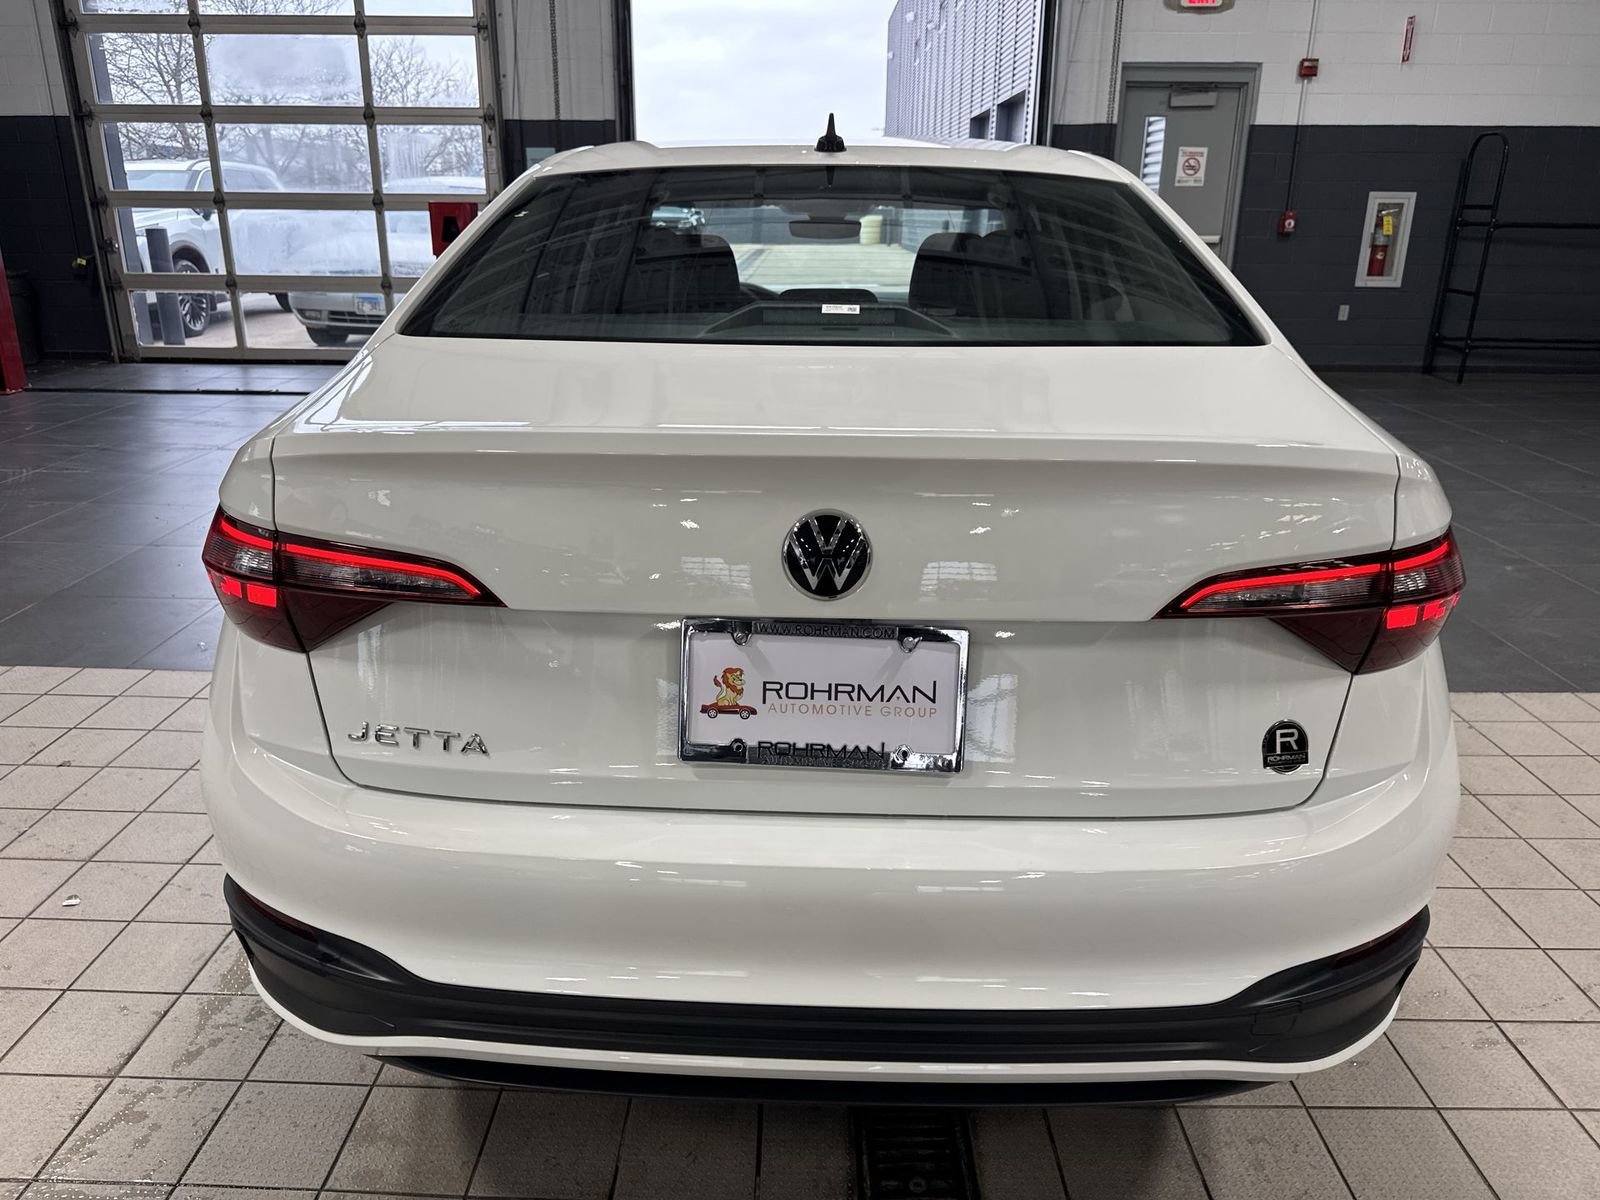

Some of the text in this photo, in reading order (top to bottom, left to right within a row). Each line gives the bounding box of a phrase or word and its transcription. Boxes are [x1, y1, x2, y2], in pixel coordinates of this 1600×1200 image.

[762, 680, 937, 704] ROHRMAN
[768, 703, 937, 718] AUTOMOTIVE GROUP
[348, 721, 490, 757] JETTA
[758, 741, 885, 759] ROHRMAN
[1276, 728, 1299, 754] R
